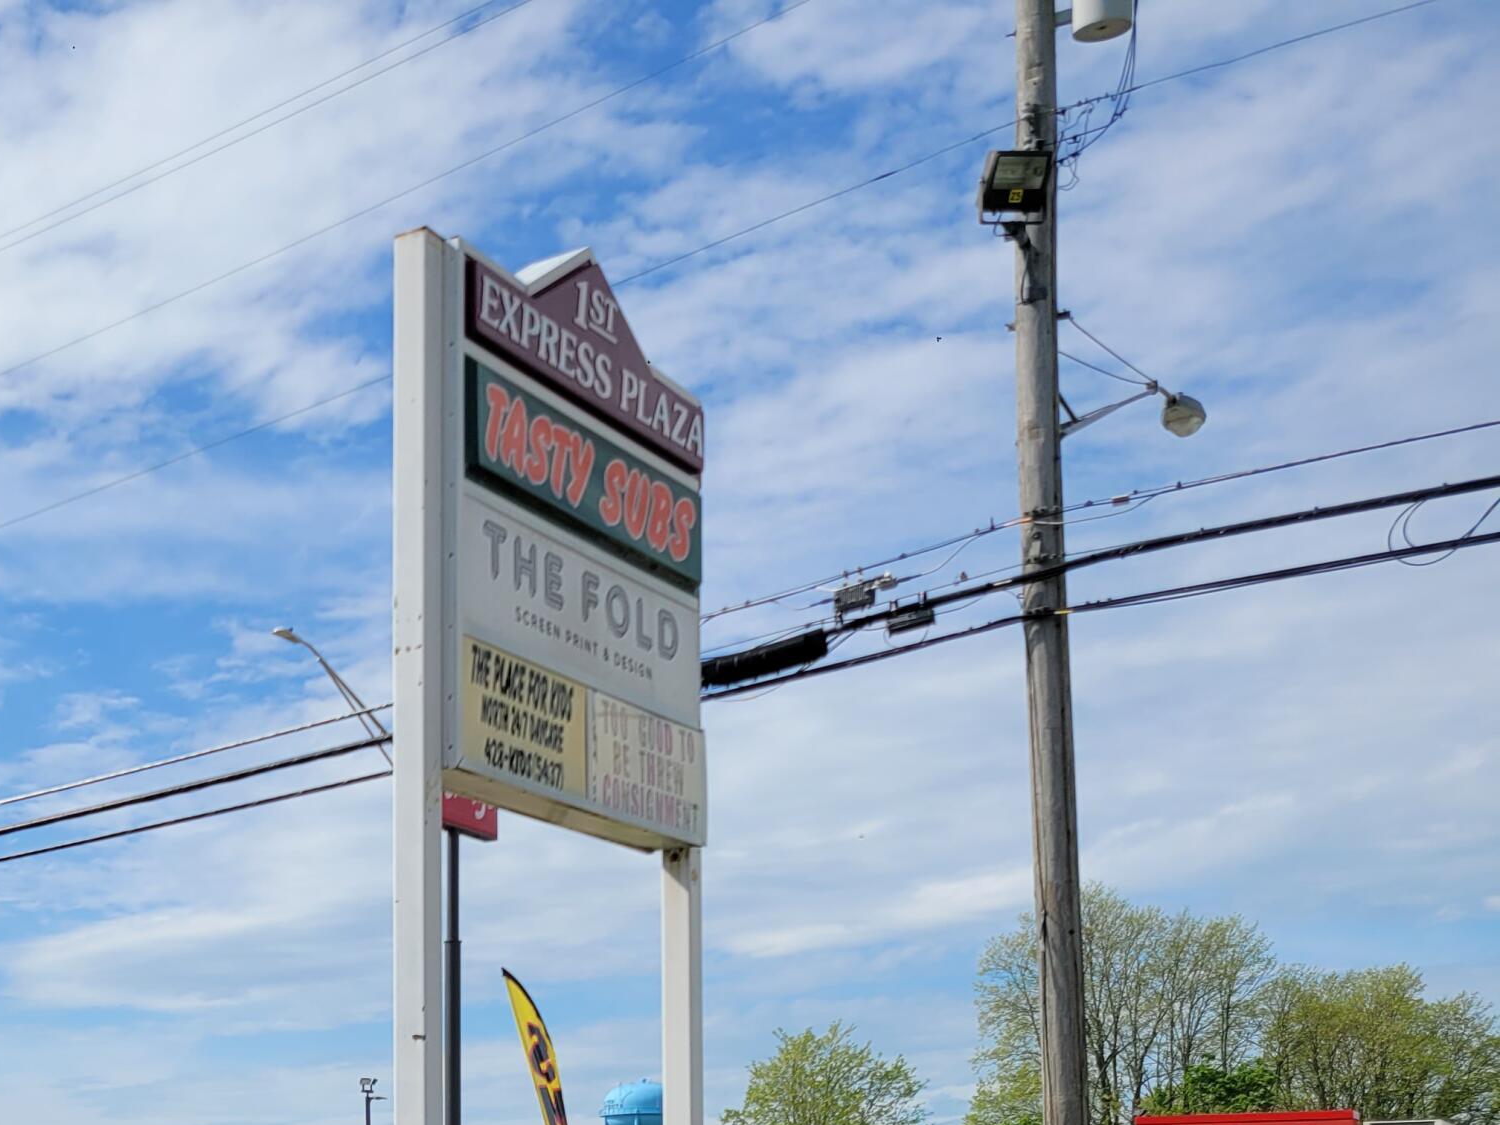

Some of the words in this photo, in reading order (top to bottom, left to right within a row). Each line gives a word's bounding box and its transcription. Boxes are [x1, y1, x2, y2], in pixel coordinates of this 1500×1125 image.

[574, 280, 618, 341] 1ST
[480, 275, 612, 399] EXPRESS
[620, 368, 701, 456] PLAZA
[485, 383, 595, 508] TASTY
[600, 459, 696, 560] SUBS
[482, 519, 565, 612] THE
[582, 570, 679, 661] FOLD
[515, 605, 560, 639] SCREEN
[565, 629, 598, 655] PRINT
[603, 648, 609, 661] &
[613, 652, 652, 680] DESIGN
[471, 644, 492, 689] THE
[493, 654, 527, 704] PLACE
[527, 670, 548, 715] FOR
[549, 679, 574, 722] KIDS
[602, 700, 628, 741] TOO
[638, 715, 672, 756] GOOD
[679, 729, 695, 764] TO
[612, 740, 630, 778] BE
[602, 773, 699, 833] CONSIGNMENT
